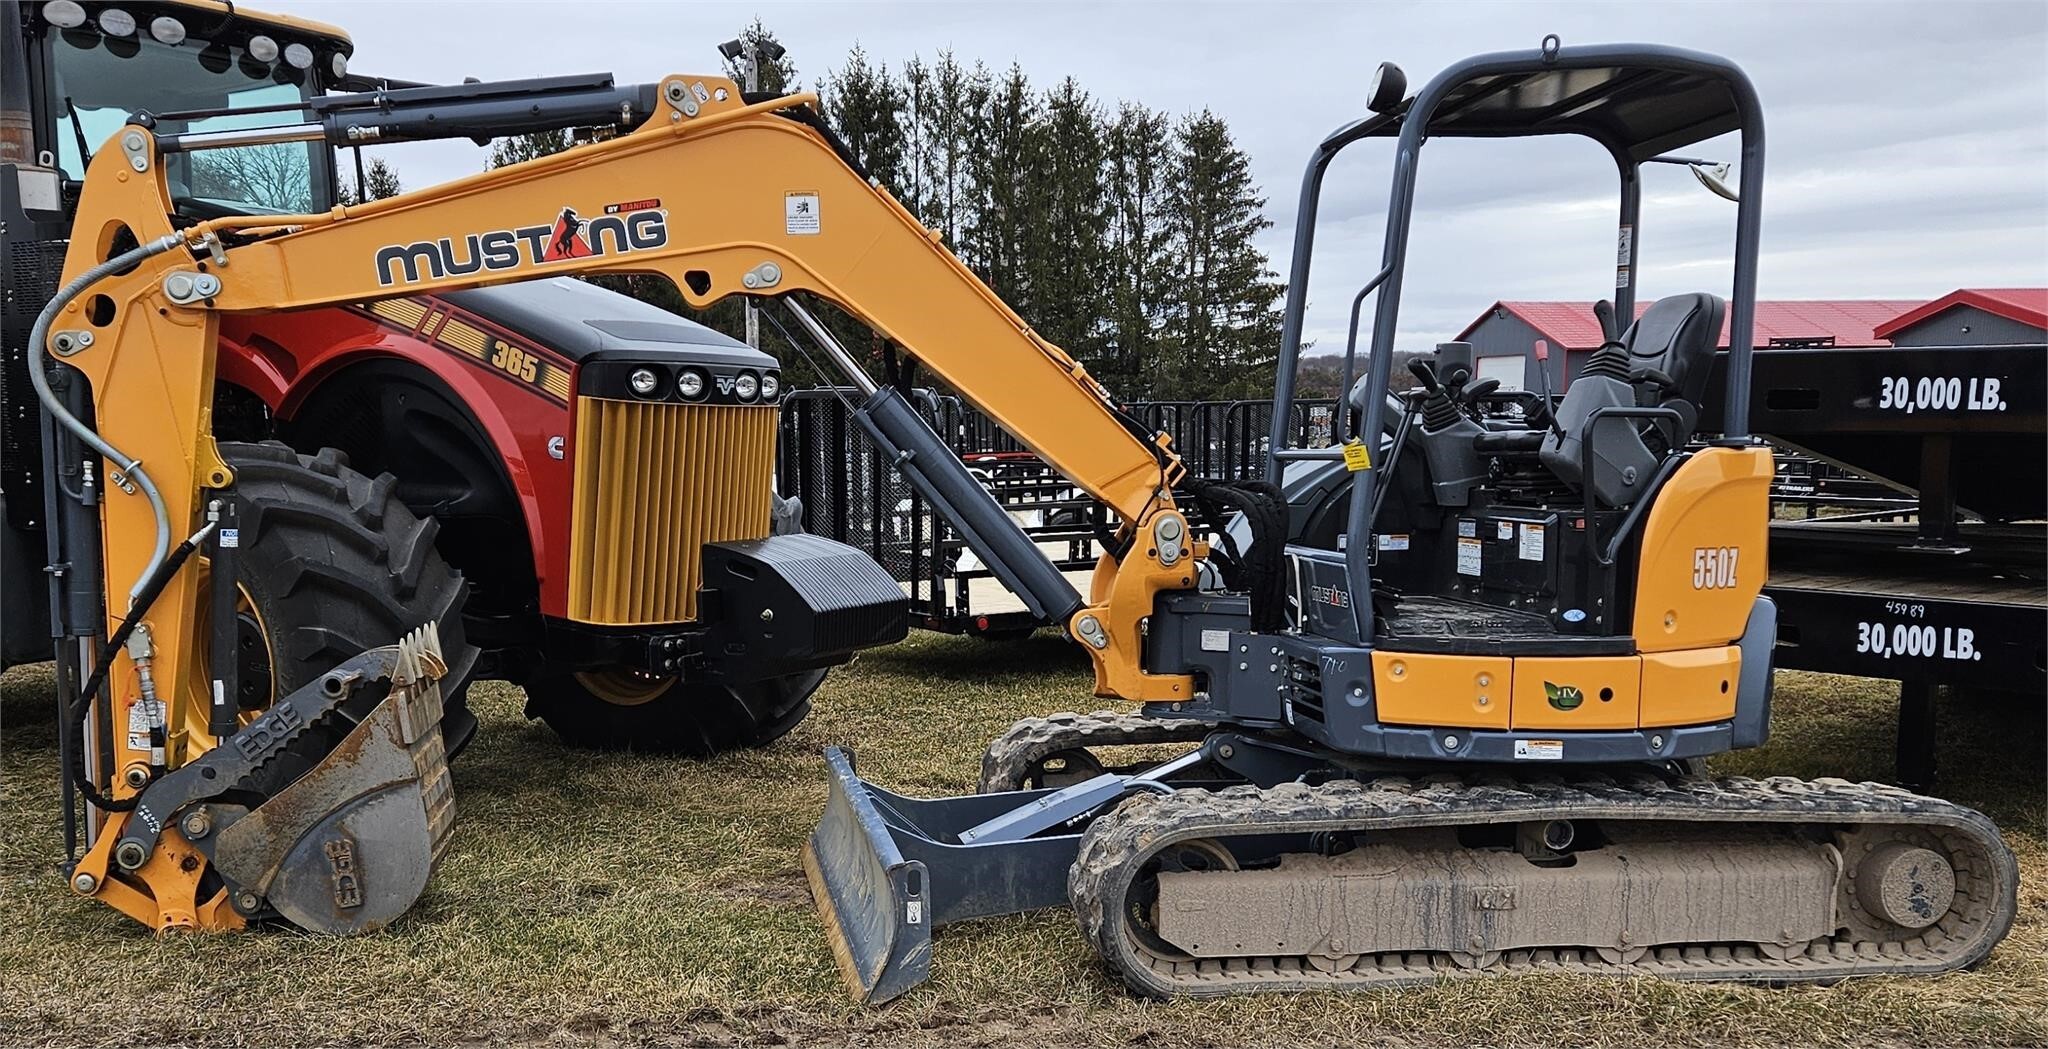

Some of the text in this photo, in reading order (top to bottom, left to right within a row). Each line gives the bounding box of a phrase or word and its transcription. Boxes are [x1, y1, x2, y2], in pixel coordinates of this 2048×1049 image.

[491, 340, 539, 383] 365
[1879, 376, 2007, 414] 30,000 LB.
[1693, 546, 1739, 590] 550Z
[1857, 622, 1982, 661] 30,000 LB.
[235, 701, 302, 761] EDGE
